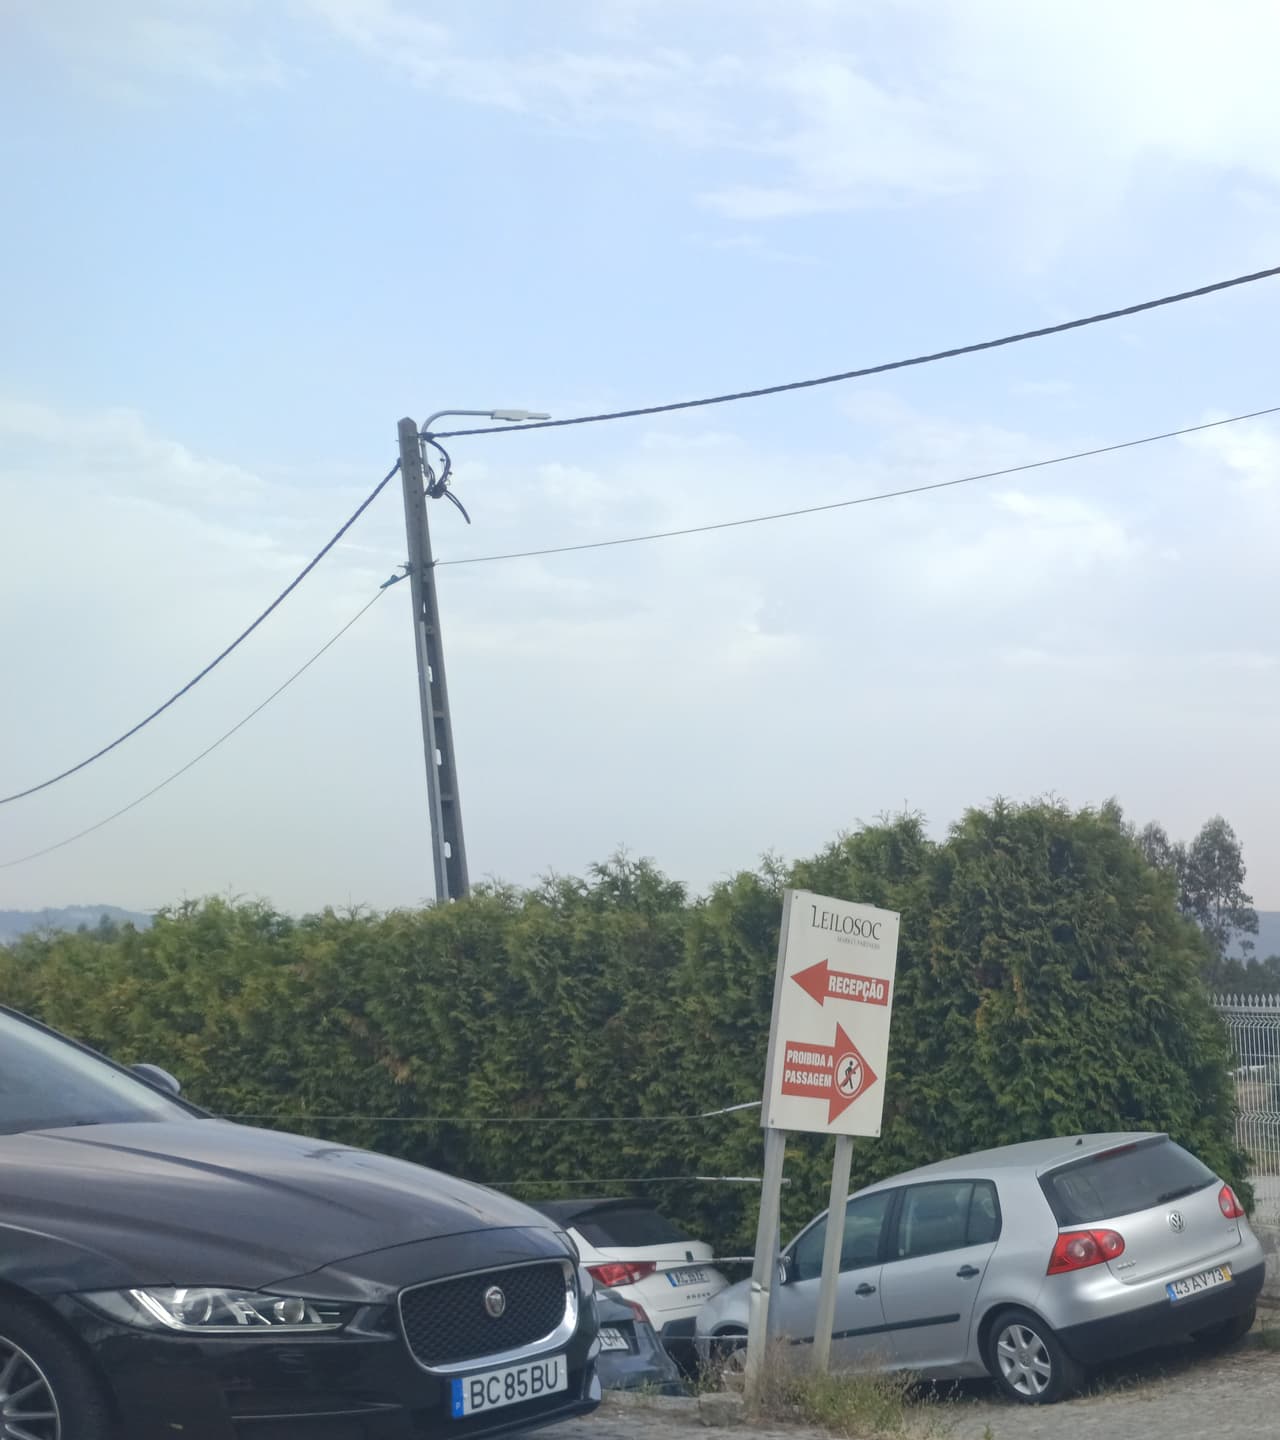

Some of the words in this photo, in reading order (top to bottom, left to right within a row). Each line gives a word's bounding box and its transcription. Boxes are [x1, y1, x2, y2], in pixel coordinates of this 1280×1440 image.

[812, 905, 881, 940] LEILOSOC
[828, 975, 884, 1002] RECEPÇÃO
[787, 1050, 825, 1067] PROIBIDA
[827, 1055, 833, 1068] A
[785, 1070, 832, 1087] PASSAGEM
[1192, 1273, 1208, 1290] AV
[470, 1376, 500, 1410] BC
[504, 1368, 528, 1400] 85
[531, 1361, 558, 1394] BU
